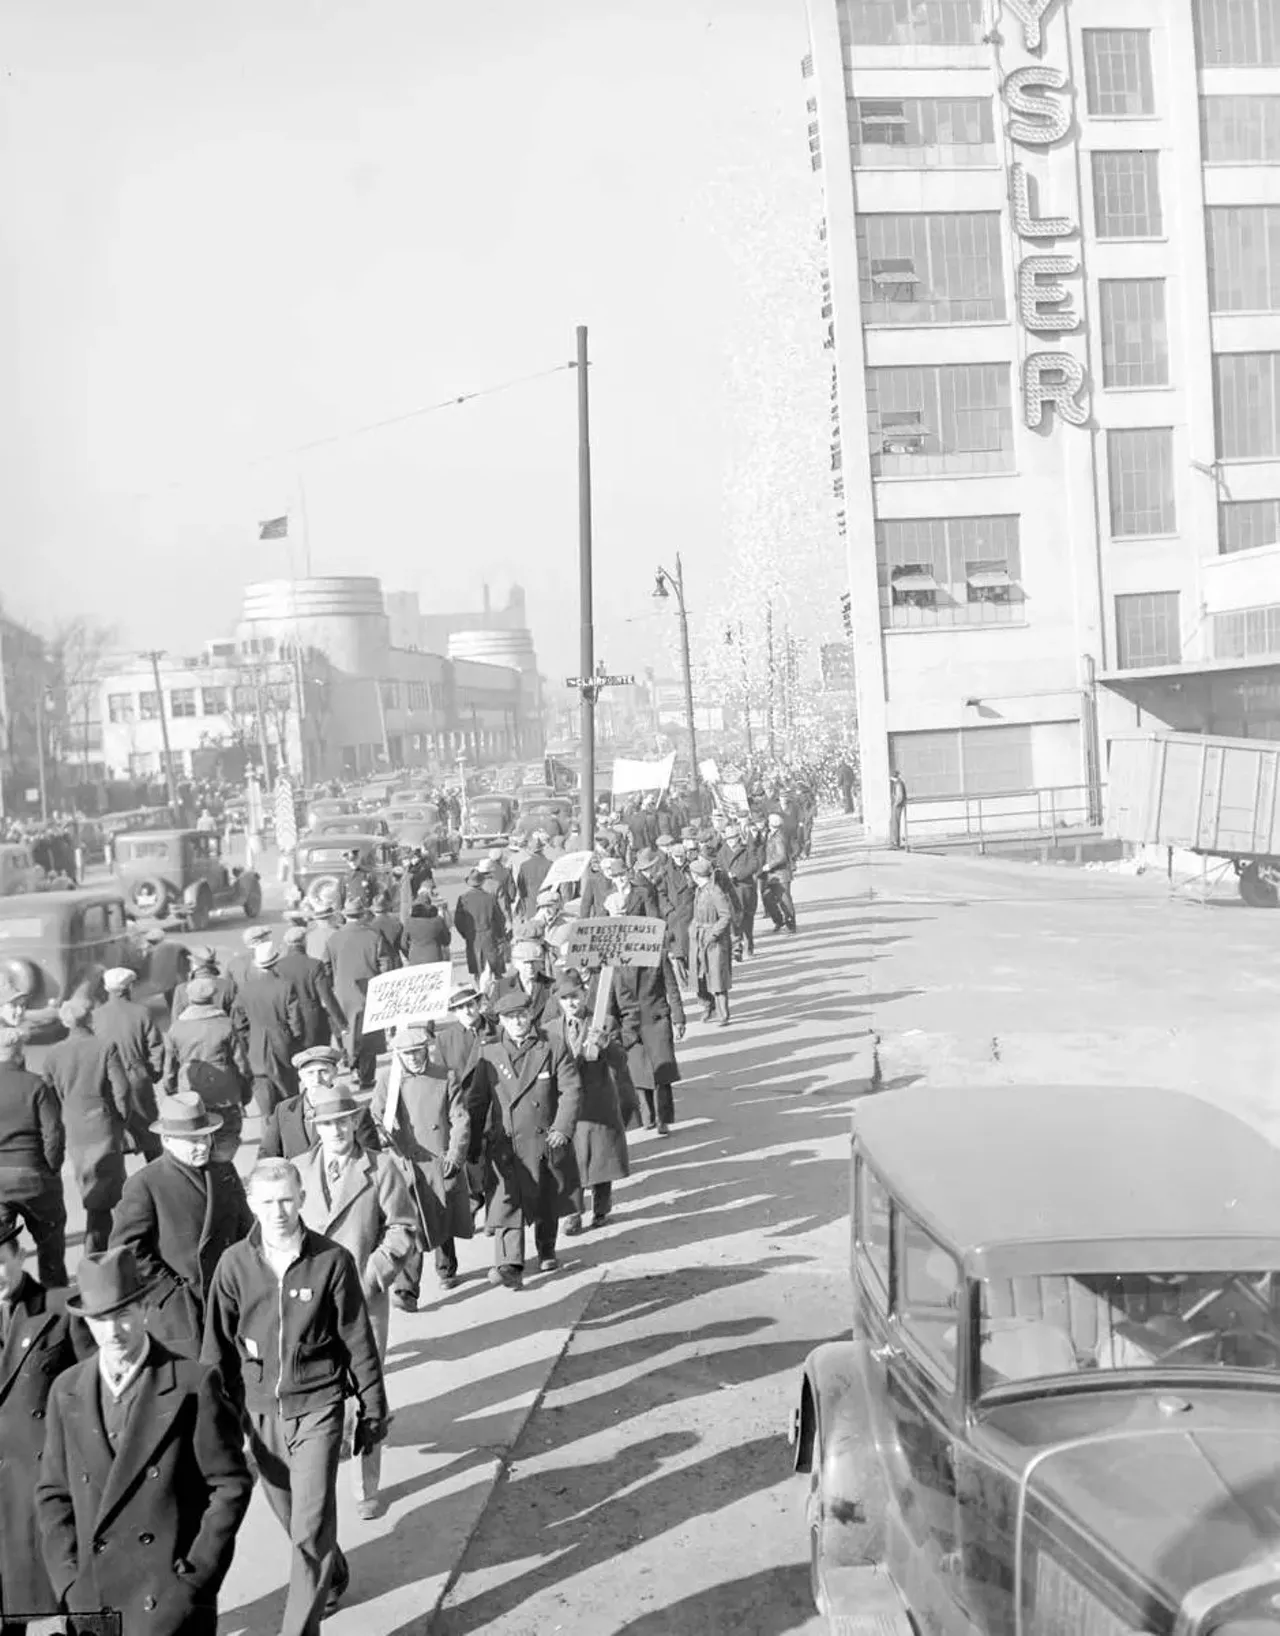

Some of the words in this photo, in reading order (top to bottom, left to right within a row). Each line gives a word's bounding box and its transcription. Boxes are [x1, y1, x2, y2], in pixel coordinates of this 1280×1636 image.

[1001, 0, 1092, 428] YSLER
[596, 925, 618, 934] BEST
[619, 924, 657, 934] BECAUSE
[591, 932, 627, 942] BIGGEST
[571, 943, 587, 953] BUT
[588, 943, 623, 952] BIGGEST
[624, 943, 661, 952] BECAUSE
[580, 957, 590, 967] U
[600, 958, 608, 966] A
[620, 957, 632, 965] W
